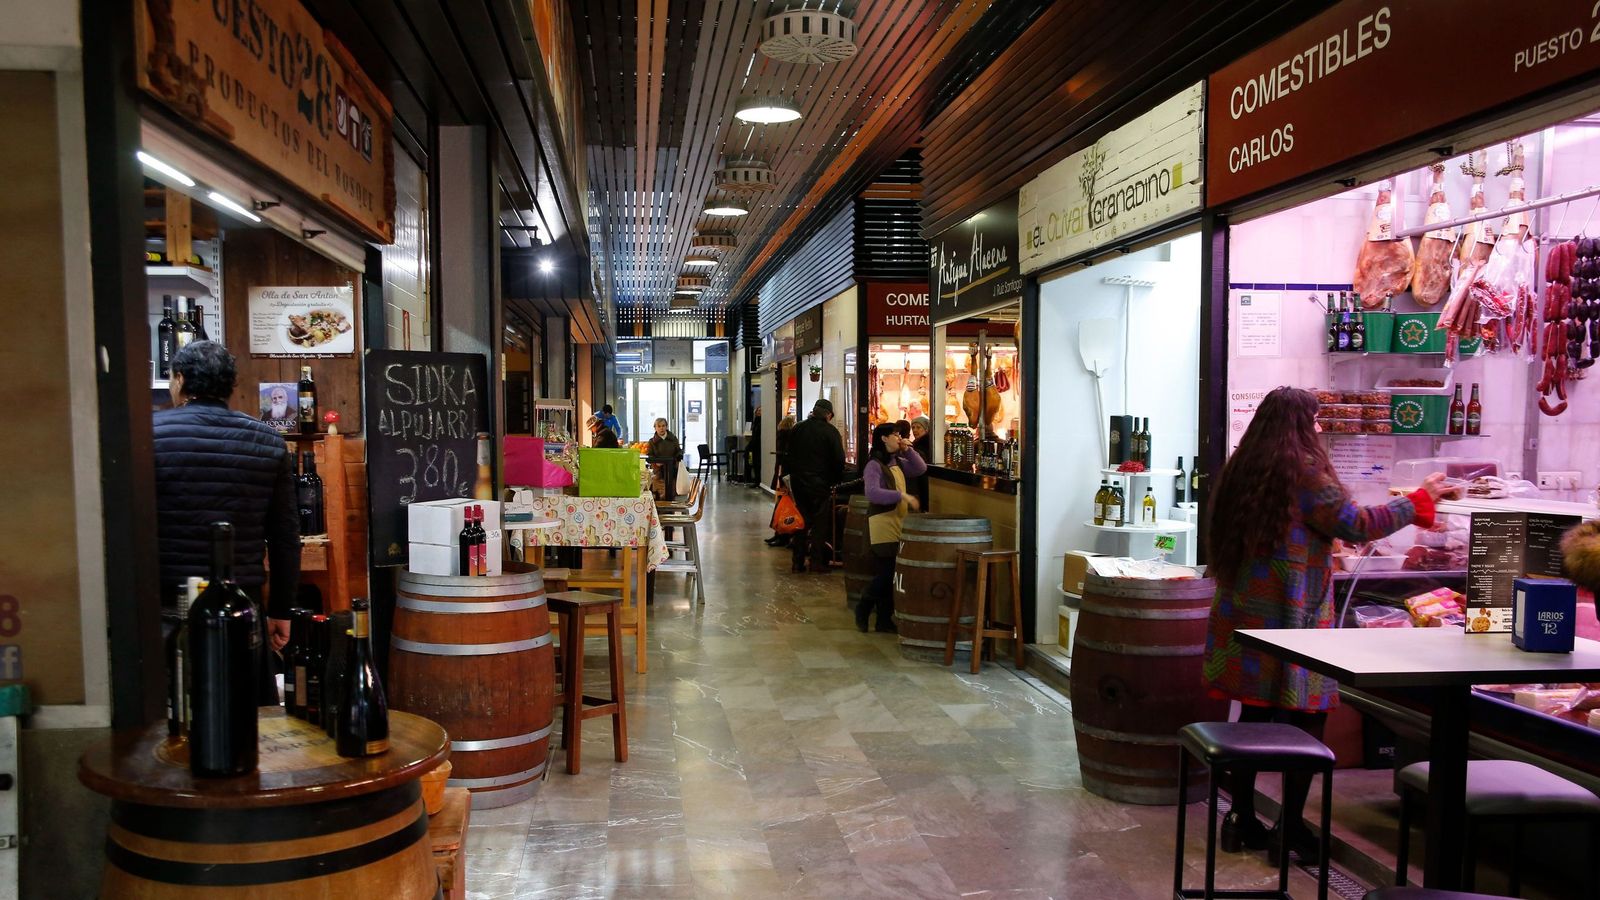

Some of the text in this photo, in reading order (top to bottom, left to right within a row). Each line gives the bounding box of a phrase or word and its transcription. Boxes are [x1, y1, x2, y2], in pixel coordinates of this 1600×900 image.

[1230, 7, 1392, 120] COMESTIBLES
[1514, 28, 1583, 73] PUESTO
[188, 40, 374, 214] PRODUCTOS DEL BOSQUE
[1229, 123, 1294, 174] CARLOS
[261, 290, 279, 300] Olla
[280, 290, 291, 299] de
[292, 290, 309, 299] San
[385, 363, 477, 406] SIDRA
[1537, 611, 1564, 620] LARIOS
[1541, 622, 1558, 634] 12
